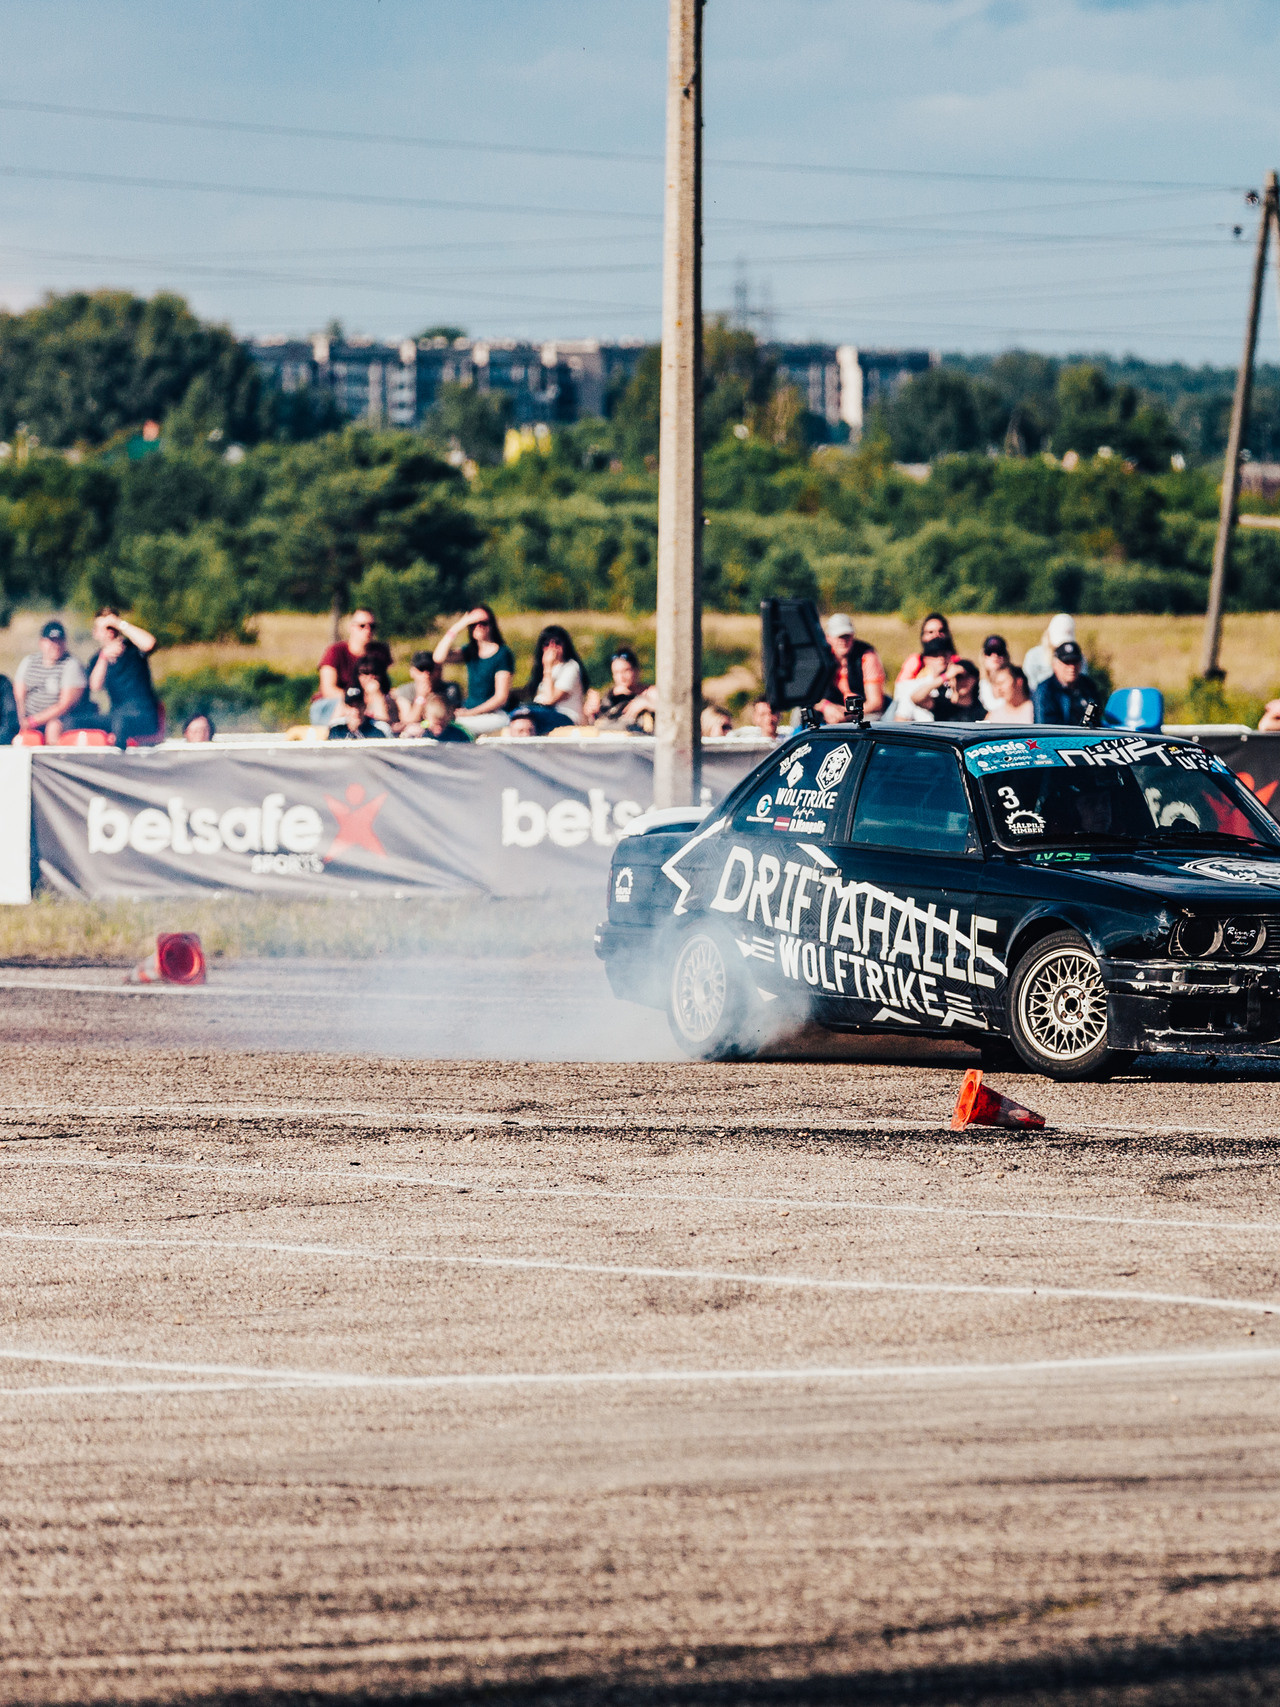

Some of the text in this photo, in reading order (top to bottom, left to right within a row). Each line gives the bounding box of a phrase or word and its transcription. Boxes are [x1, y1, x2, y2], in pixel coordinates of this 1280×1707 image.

[87, 793, 324, 854] betsafe
[501, 787, 713, 848] bets
[775, 788, 838, 809] WOLFTRIKE
[997, 786, 1020, 810] 3
[251, 852, 325, 874] SPORTS
[709, 845, 998, 989] DRIFTAHALLE
[779, 934, 945, 1018] WOLFTRIKE
